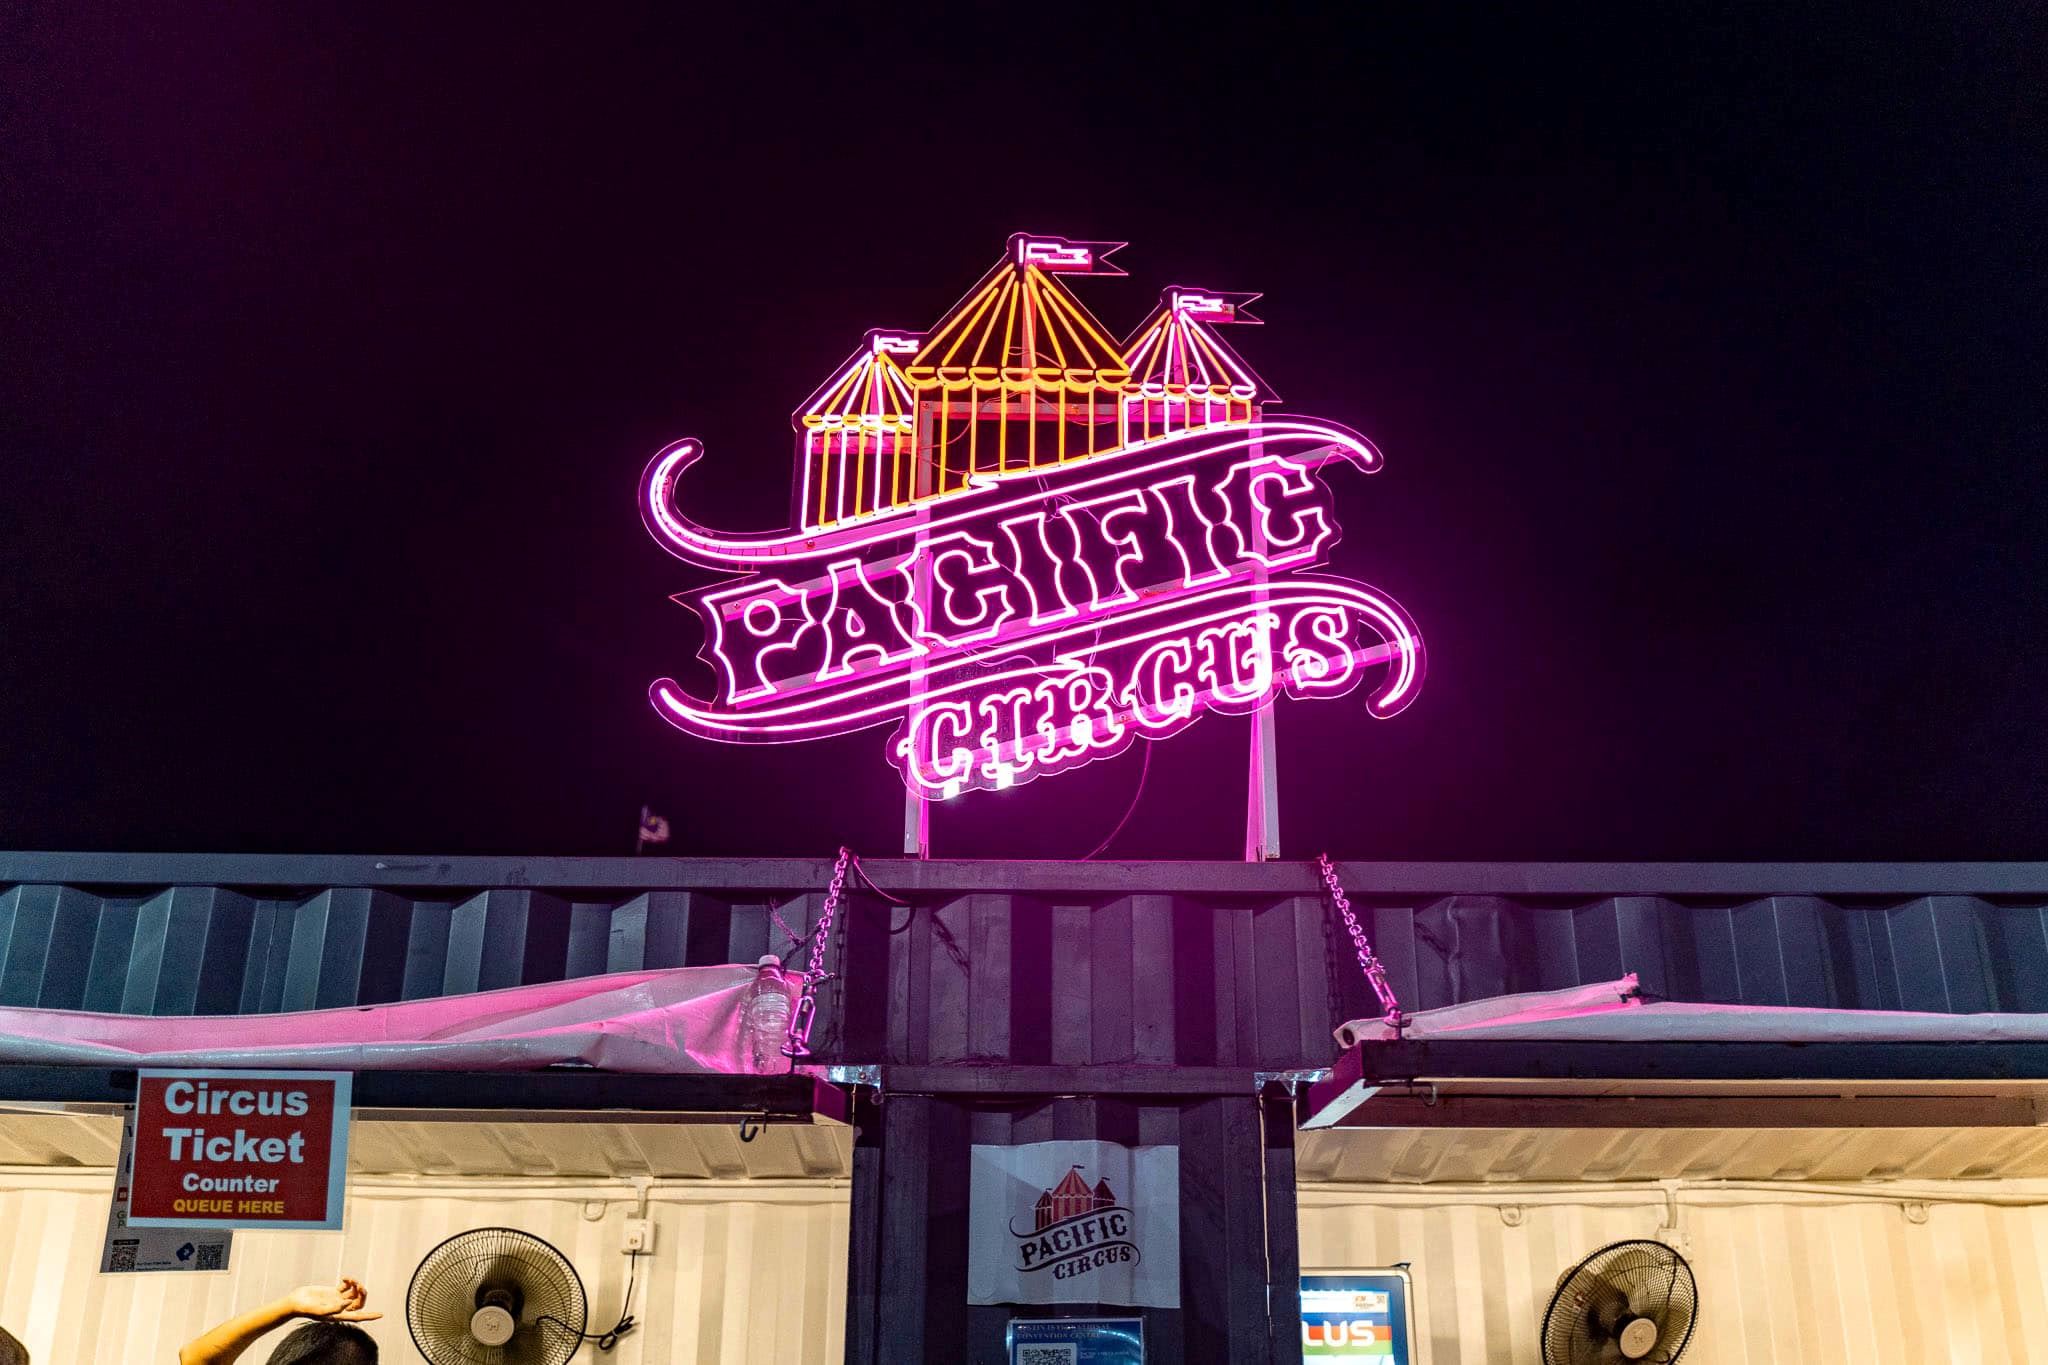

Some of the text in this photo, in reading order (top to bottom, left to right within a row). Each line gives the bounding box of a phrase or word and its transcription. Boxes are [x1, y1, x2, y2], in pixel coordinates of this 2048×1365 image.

[704, 456, 1333, 705] PACIFIC
[901, 605, 1354, 791] CIRCUS
[164, 1081, 310, 1116] Circus
[162, 1128, 305, 1163] Ticket
[182, 1172, 280, 1193] Counter
[173, 1199, 285, 1214] QUEUE HERE
[1020, 1214, 1127, 1266] PACIFIC
[1053, 1246, 1131, 1280] CIRCUS
